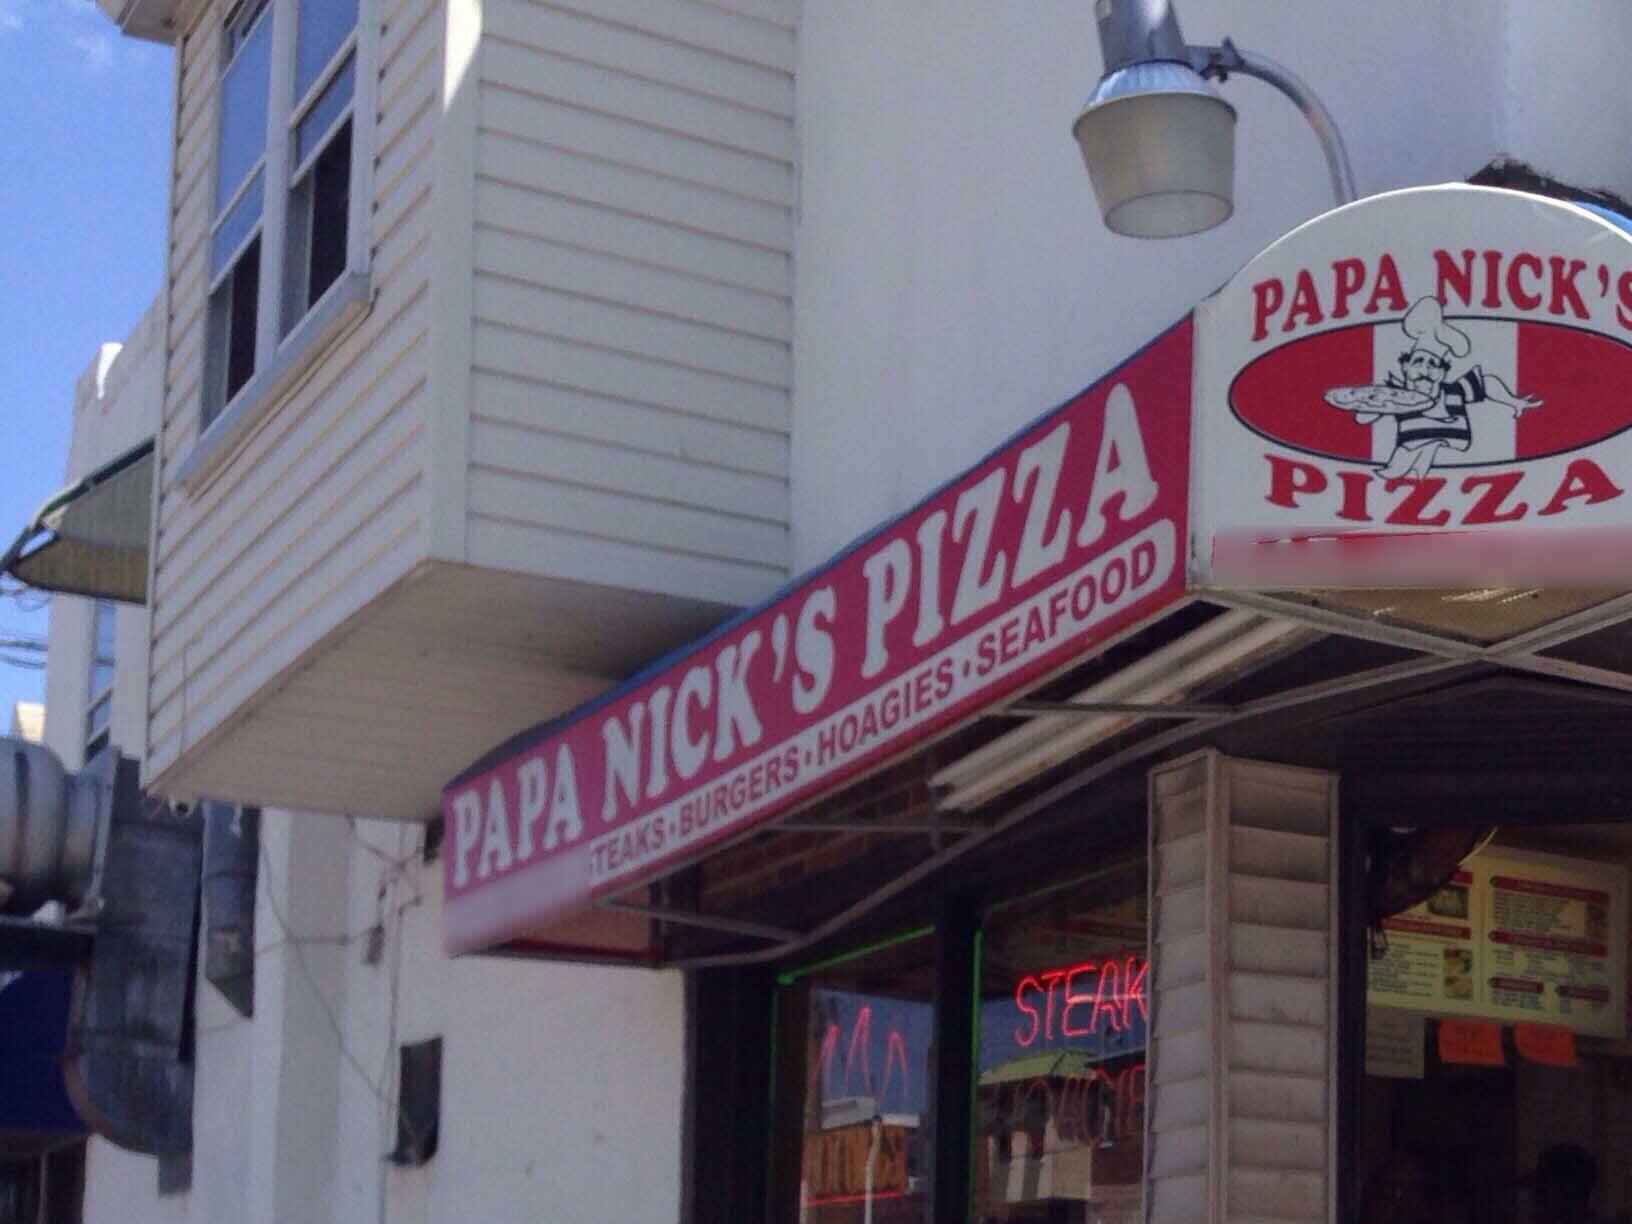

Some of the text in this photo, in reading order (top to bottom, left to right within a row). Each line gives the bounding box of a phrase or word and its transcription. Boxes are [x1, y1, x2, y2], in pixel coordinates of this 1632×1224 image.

[1252, 252, 1409, 341] PAPA
[1263, 454, 1625, 527] PIZZA
[451, 382, 1159, 888] PAPA NICK'S PIZZA
[588, 815, 665, 876] TEAKS
[679, 745, 800, 841] BURGERS
[817, 659, 955, 768] HOAGIES
[976, 539, 1156, 678] SEAFOOD
